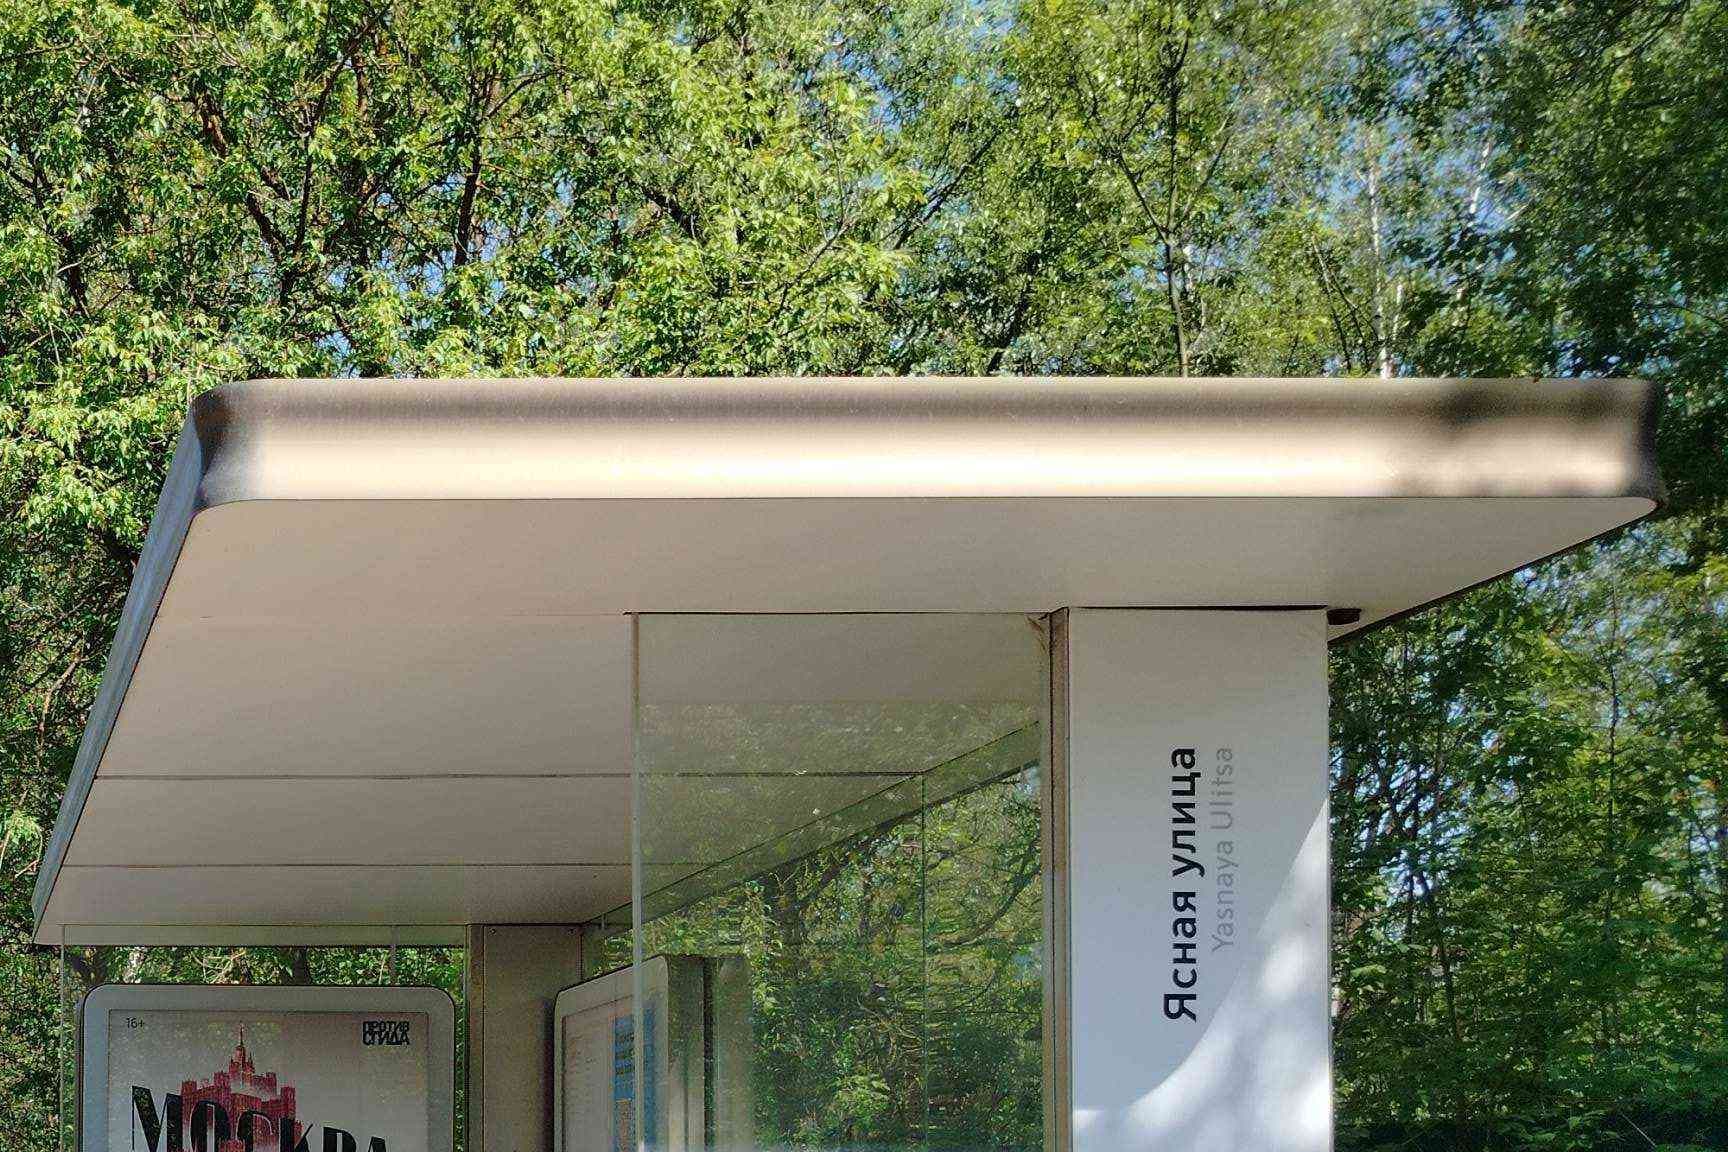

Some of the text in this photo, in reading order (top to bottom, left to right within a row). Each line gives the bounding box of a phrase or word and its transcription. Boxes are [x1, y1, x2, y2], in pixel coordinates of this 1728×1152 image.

[1163, 748, 1205, 1023] Ясная улица
[1210, 748, 1239, 952] Yasnaya Ulitsa
